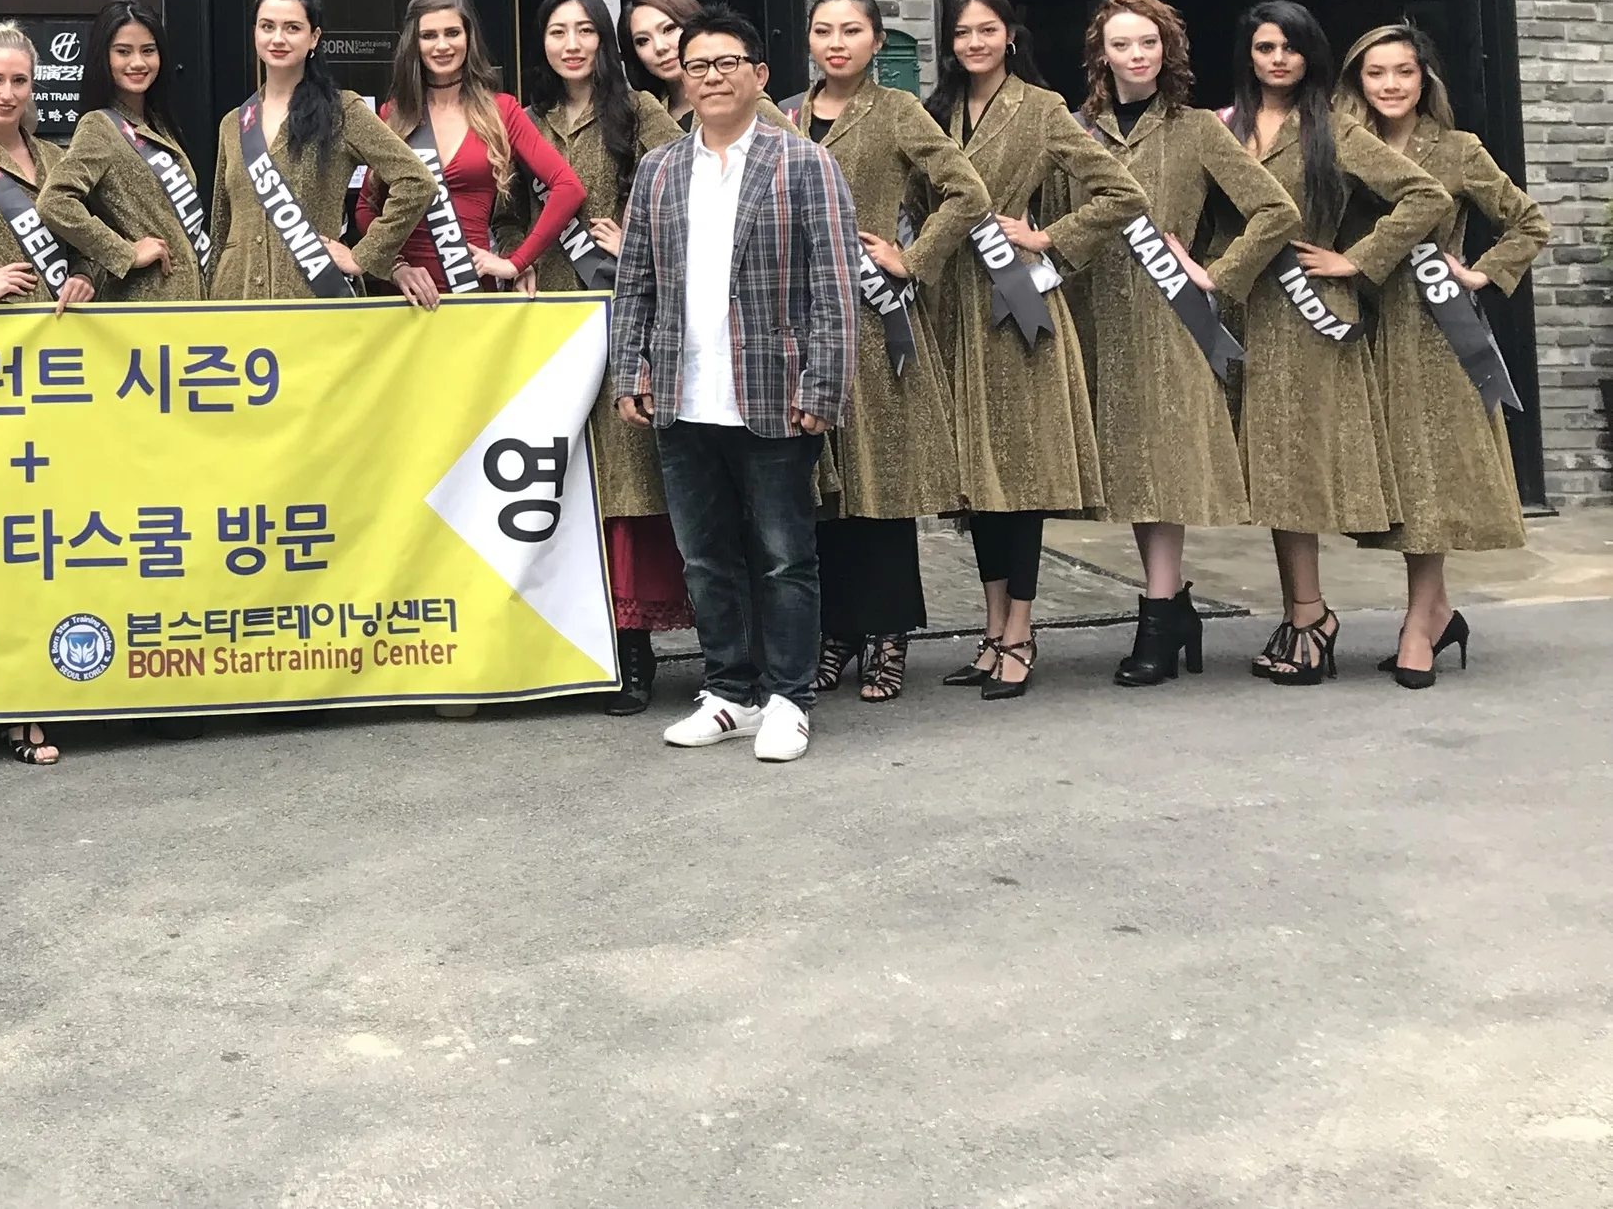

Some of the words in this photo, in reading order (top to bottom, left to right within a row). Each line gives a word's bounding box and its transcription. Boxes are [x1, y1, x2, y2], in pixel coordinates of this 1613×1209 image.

[10, 207, 70, 295] BELG
[247, 152, 332, 281] ESTONIA
[970, 214, 1015, 270] ND
[859, 245, 901, 315] TAN
[1122, 215, 1188, 301] NADA
[1278, 266, 1352, 341] INDIA
[115, 344, 280, 414] 시즌9
[482, 436, 569, 543] 영
[217, 504, 336, 576] 방문
[71, 615, 101, 628] Training
[126, 598, 458, 648] 본스타트레이닝센터
[59, 665, 81, 680] SEOUL
[83, 663, 107, 680] KOREA
[128, 647, 205, 679] BORN
[213, 642, 363, 675] Startraining
[373, 638, 458, 667] Center
